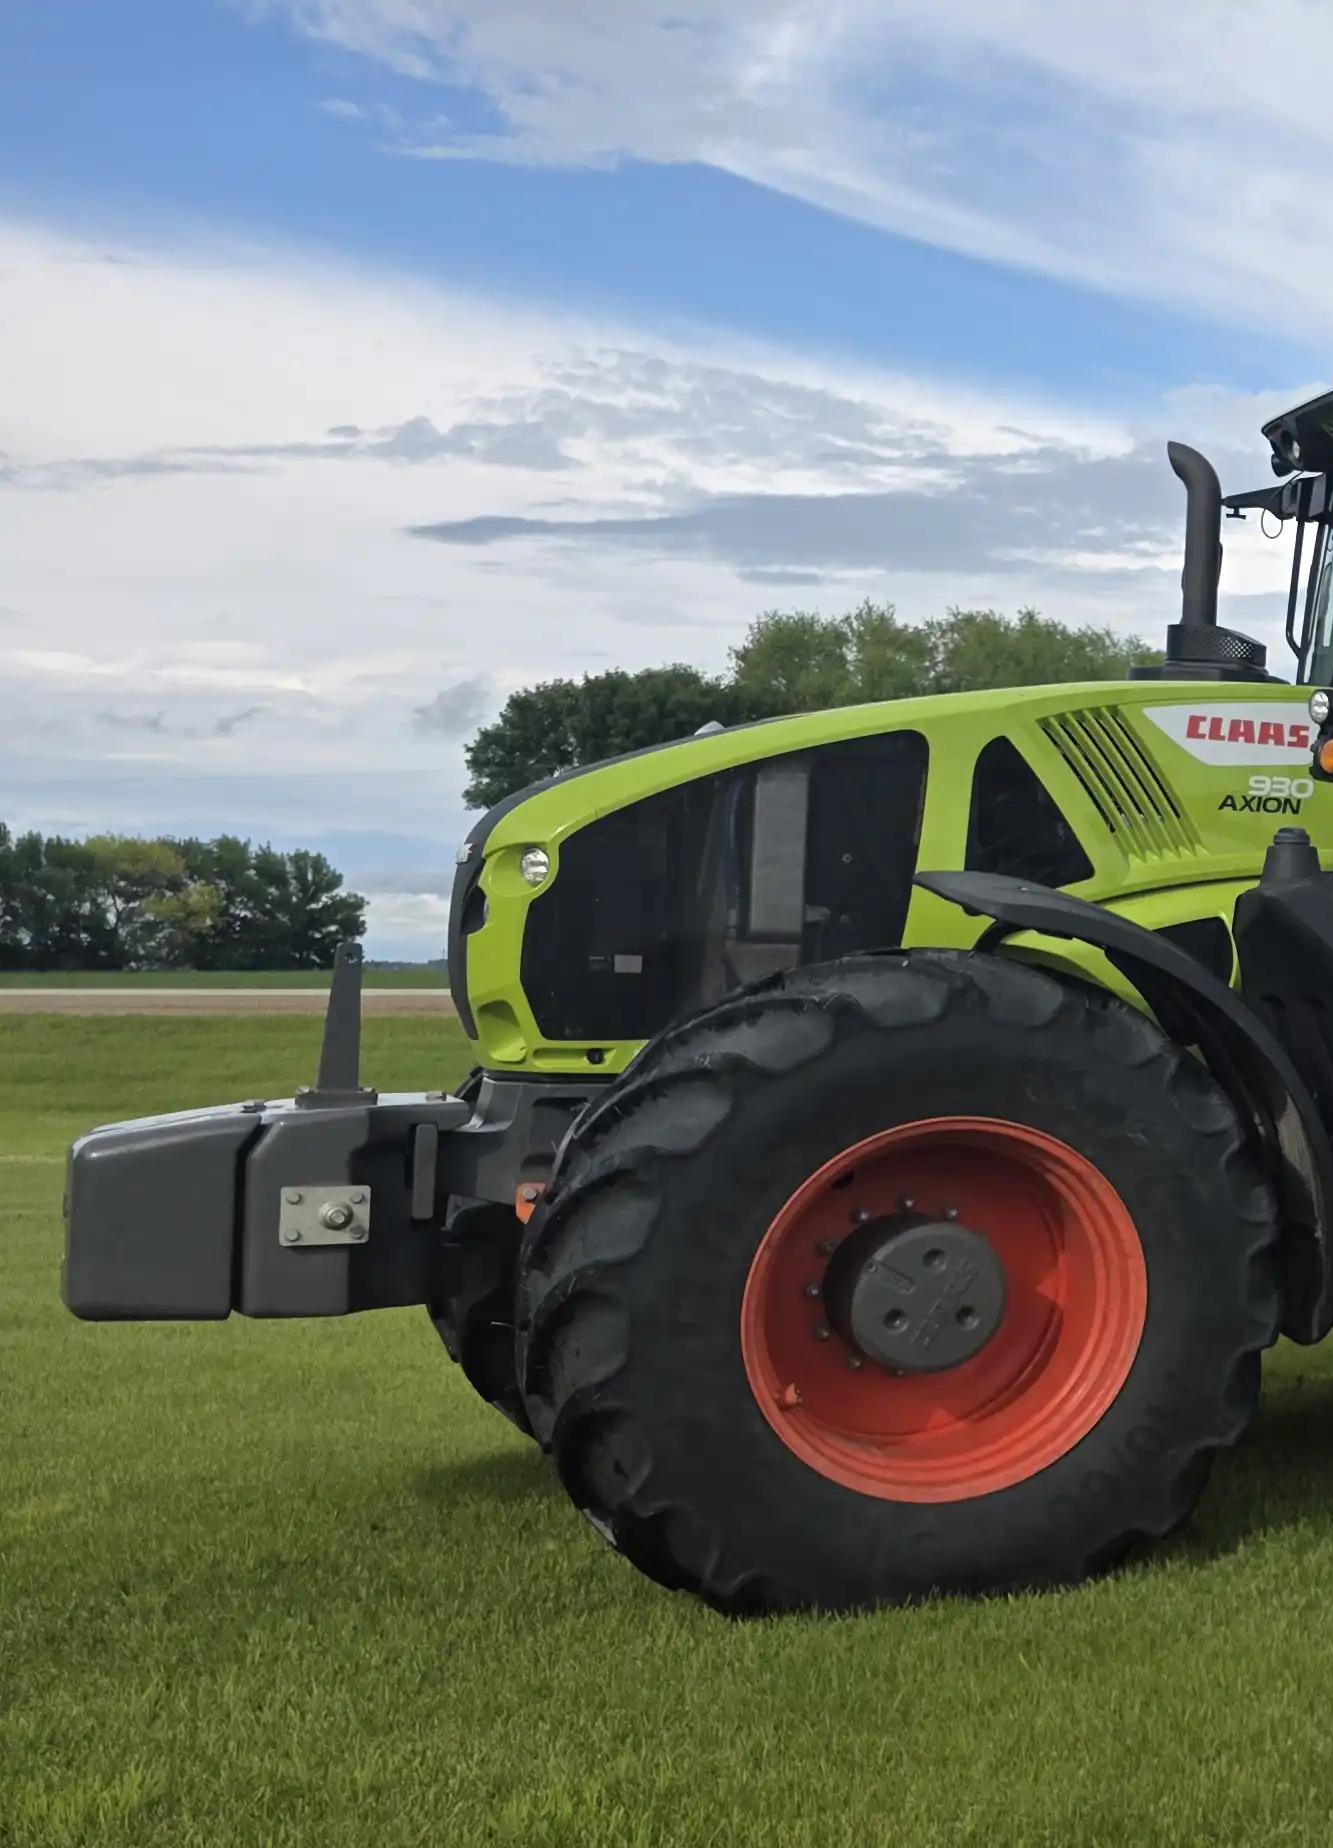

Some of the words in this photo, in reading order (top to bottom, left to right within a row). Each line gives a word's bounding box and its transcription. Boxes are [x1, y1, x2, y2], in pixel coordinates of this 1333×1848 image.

[1186, 714, 1310, 749] CLAAS
[1248, 775, 1315, 799] 930
[1217, 794, 1302, 815] AXION
